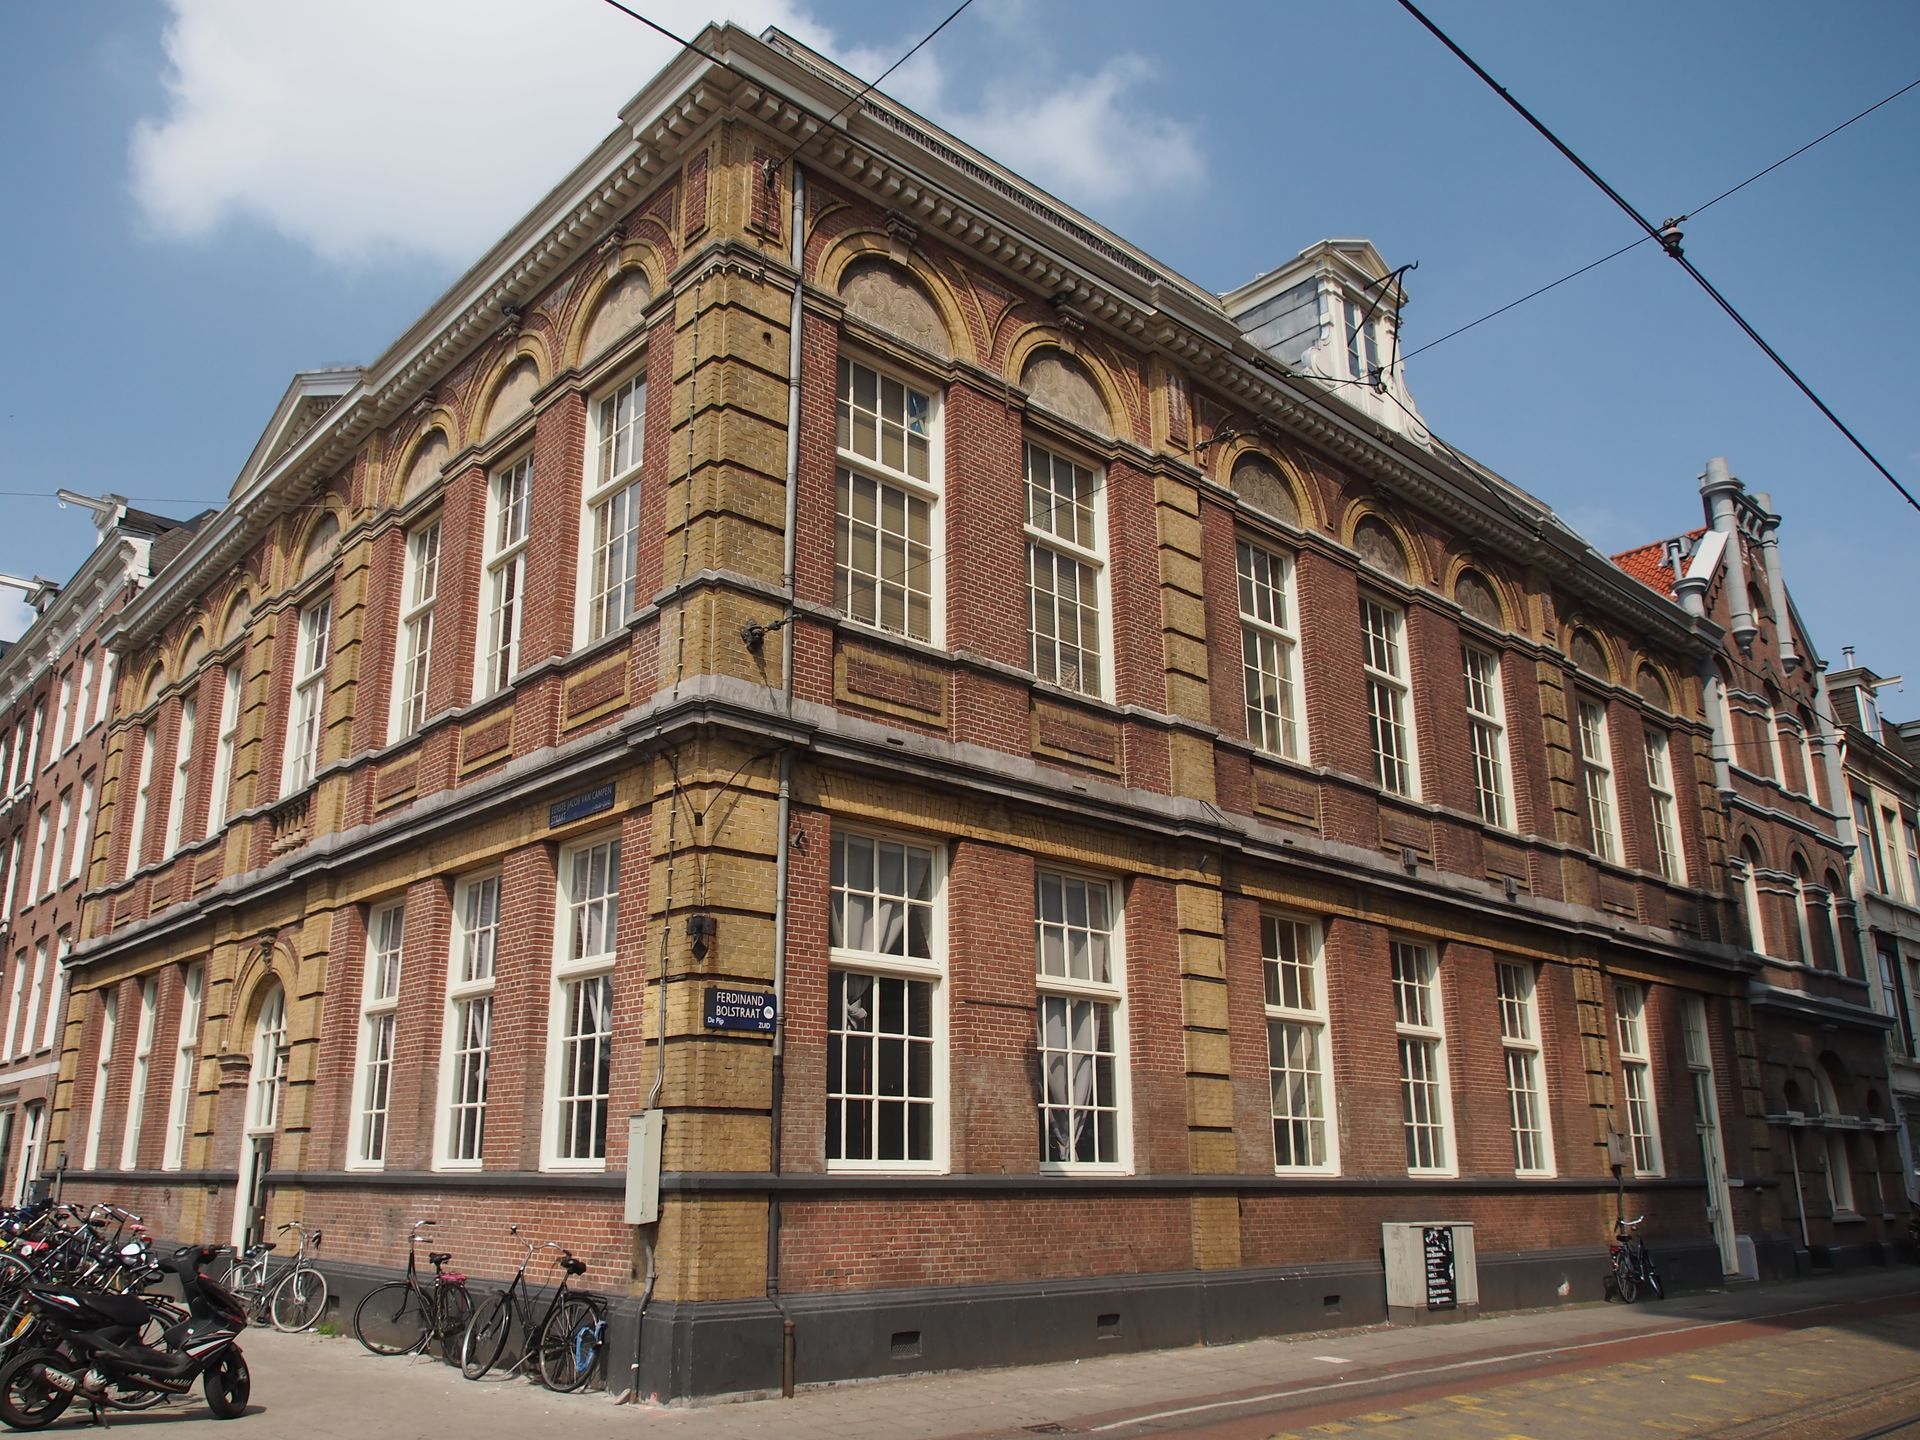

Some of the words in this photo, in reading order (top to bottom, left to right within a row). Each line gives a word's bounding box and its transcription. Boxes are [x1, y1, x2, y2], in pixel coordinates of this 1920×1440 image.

[567, 797, 580, 812] JACOB
[581, 793, 592, 803] VAN
[592, 787, 612, 800] CAMPEN
[551, 812, 567, 823] STRAAT
[716, 991, 764, 1006] FERDINAND
[716, 1005, 761, 1018] BOLSTRAAT
[715, 1017, 724, 1025] Pijp
